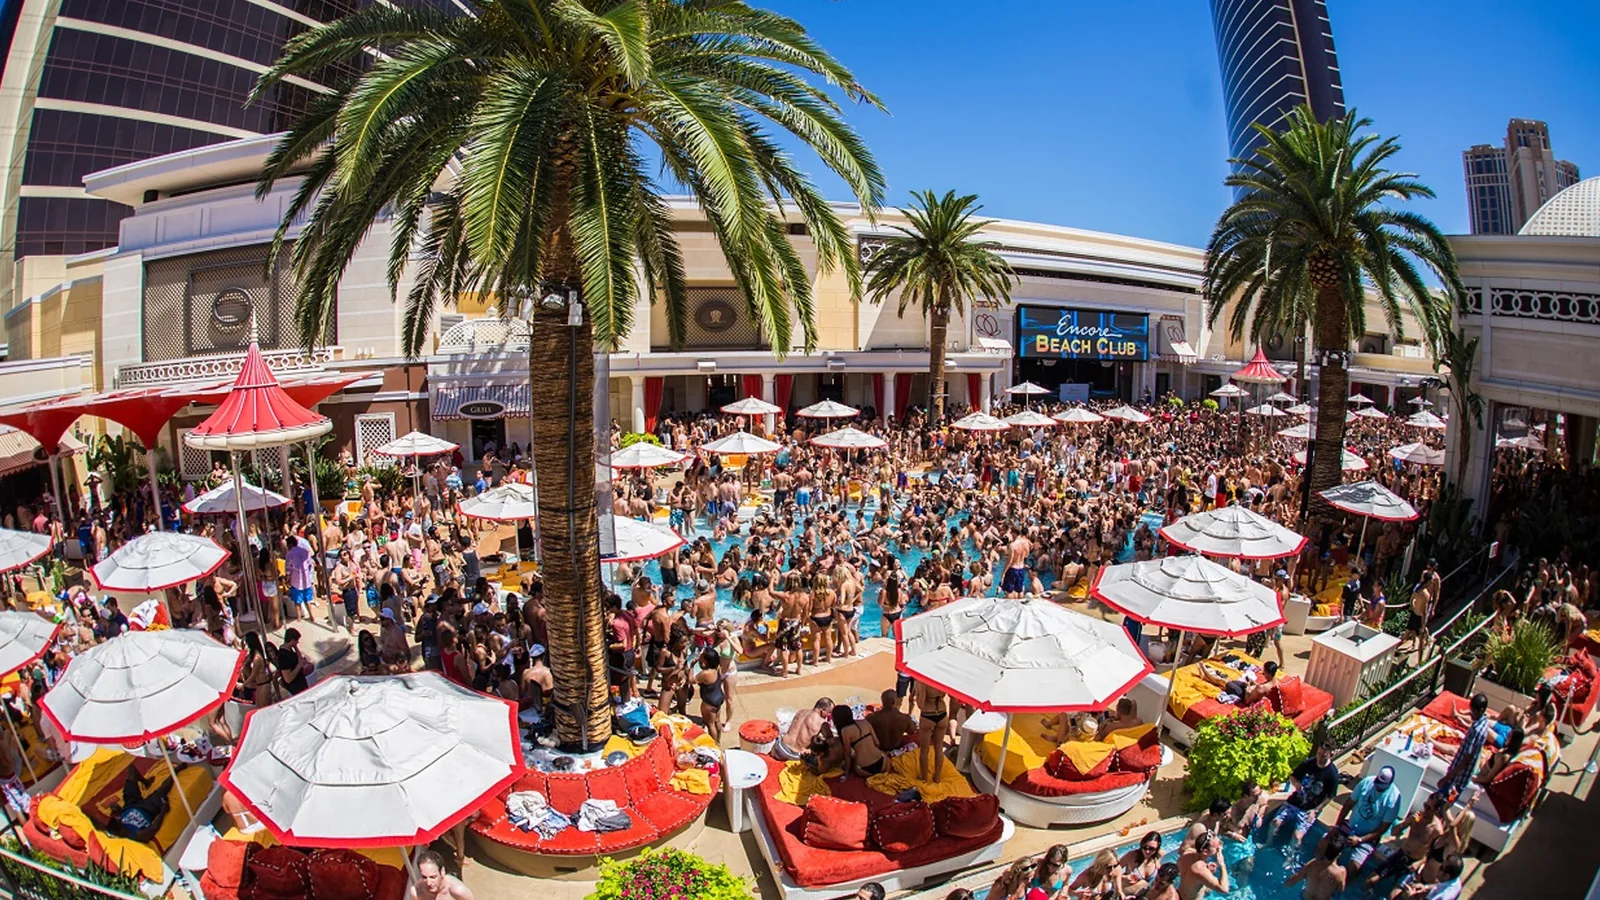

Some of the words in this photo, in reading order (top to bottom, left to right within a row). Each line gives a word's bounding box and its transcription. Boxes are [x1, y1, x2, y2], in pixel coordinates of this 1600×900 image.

[1057, 314, 1122, 337] Encore
[1036, 334, 1091, 353] BEACH
[1097, 338, 1136, 355] CLUB
